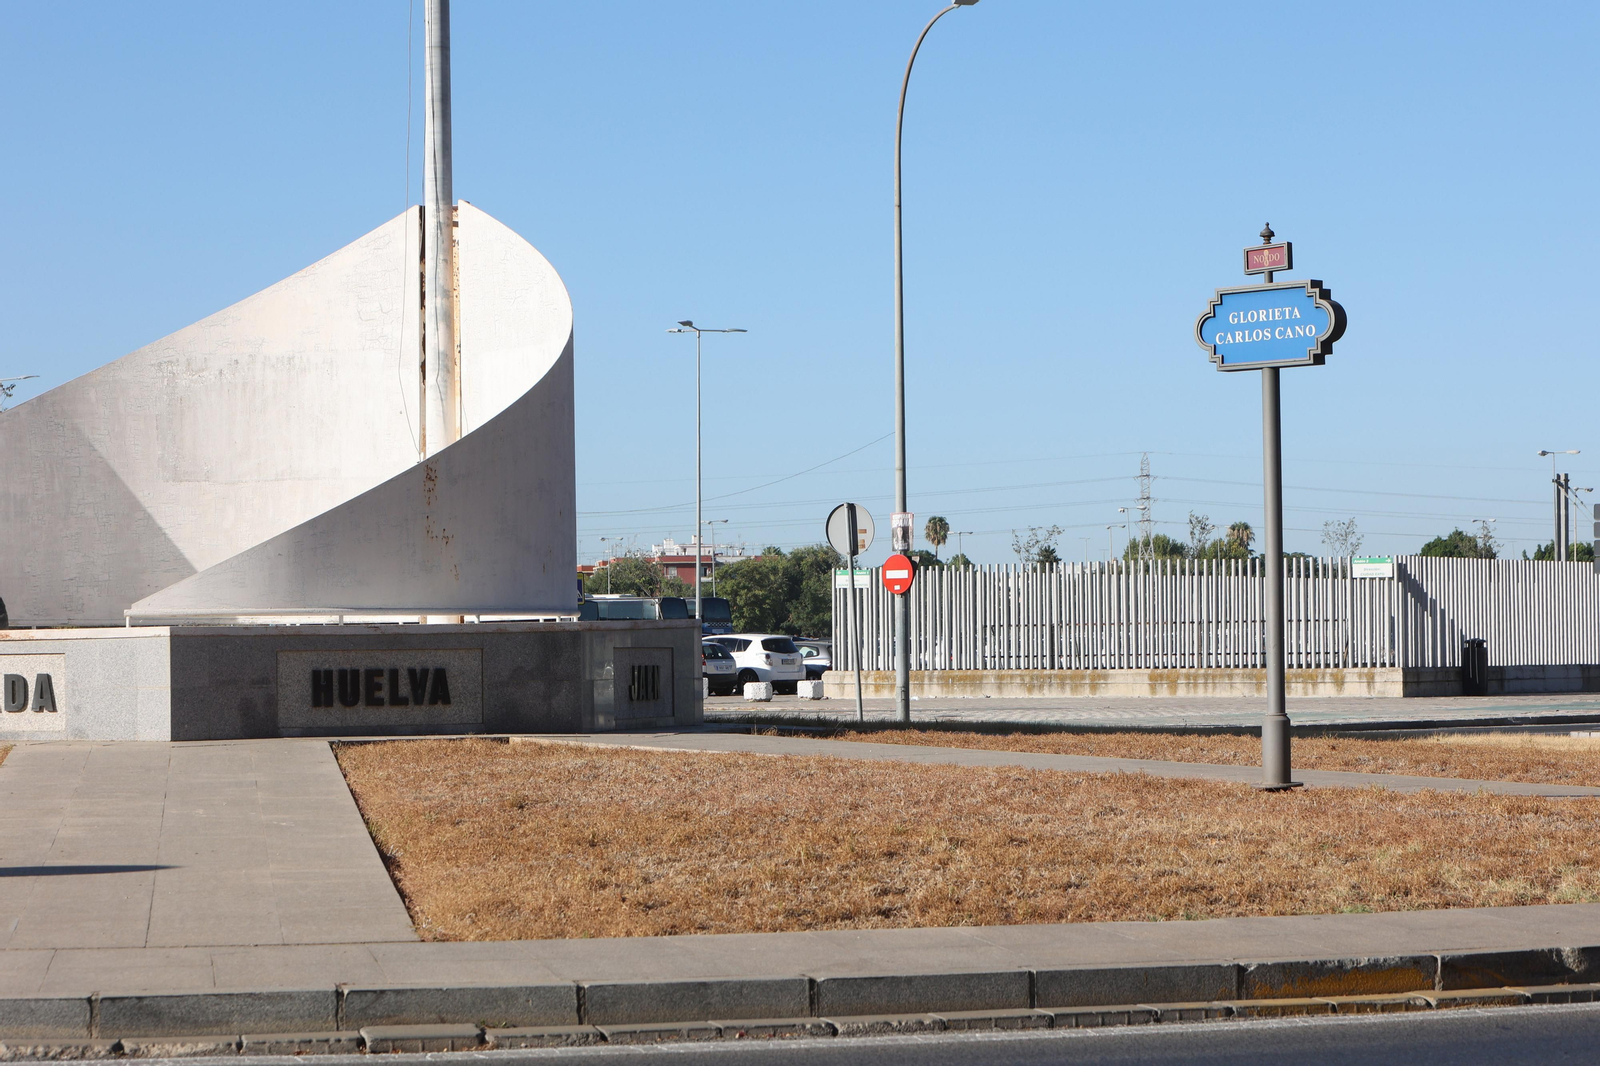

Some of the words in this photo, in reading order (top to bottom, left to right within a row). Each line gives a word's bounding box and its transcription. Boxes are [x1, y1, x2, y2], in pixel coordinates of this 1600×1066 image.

[1229, 307, 1301, 325] GLORIETA
[1215, 327, 1272, 345] CARLOS
[1275, 324, 1316, 340] CANO
[0, 673, 58, 713] DA
[312, 668, 451, 707] HUELVA
